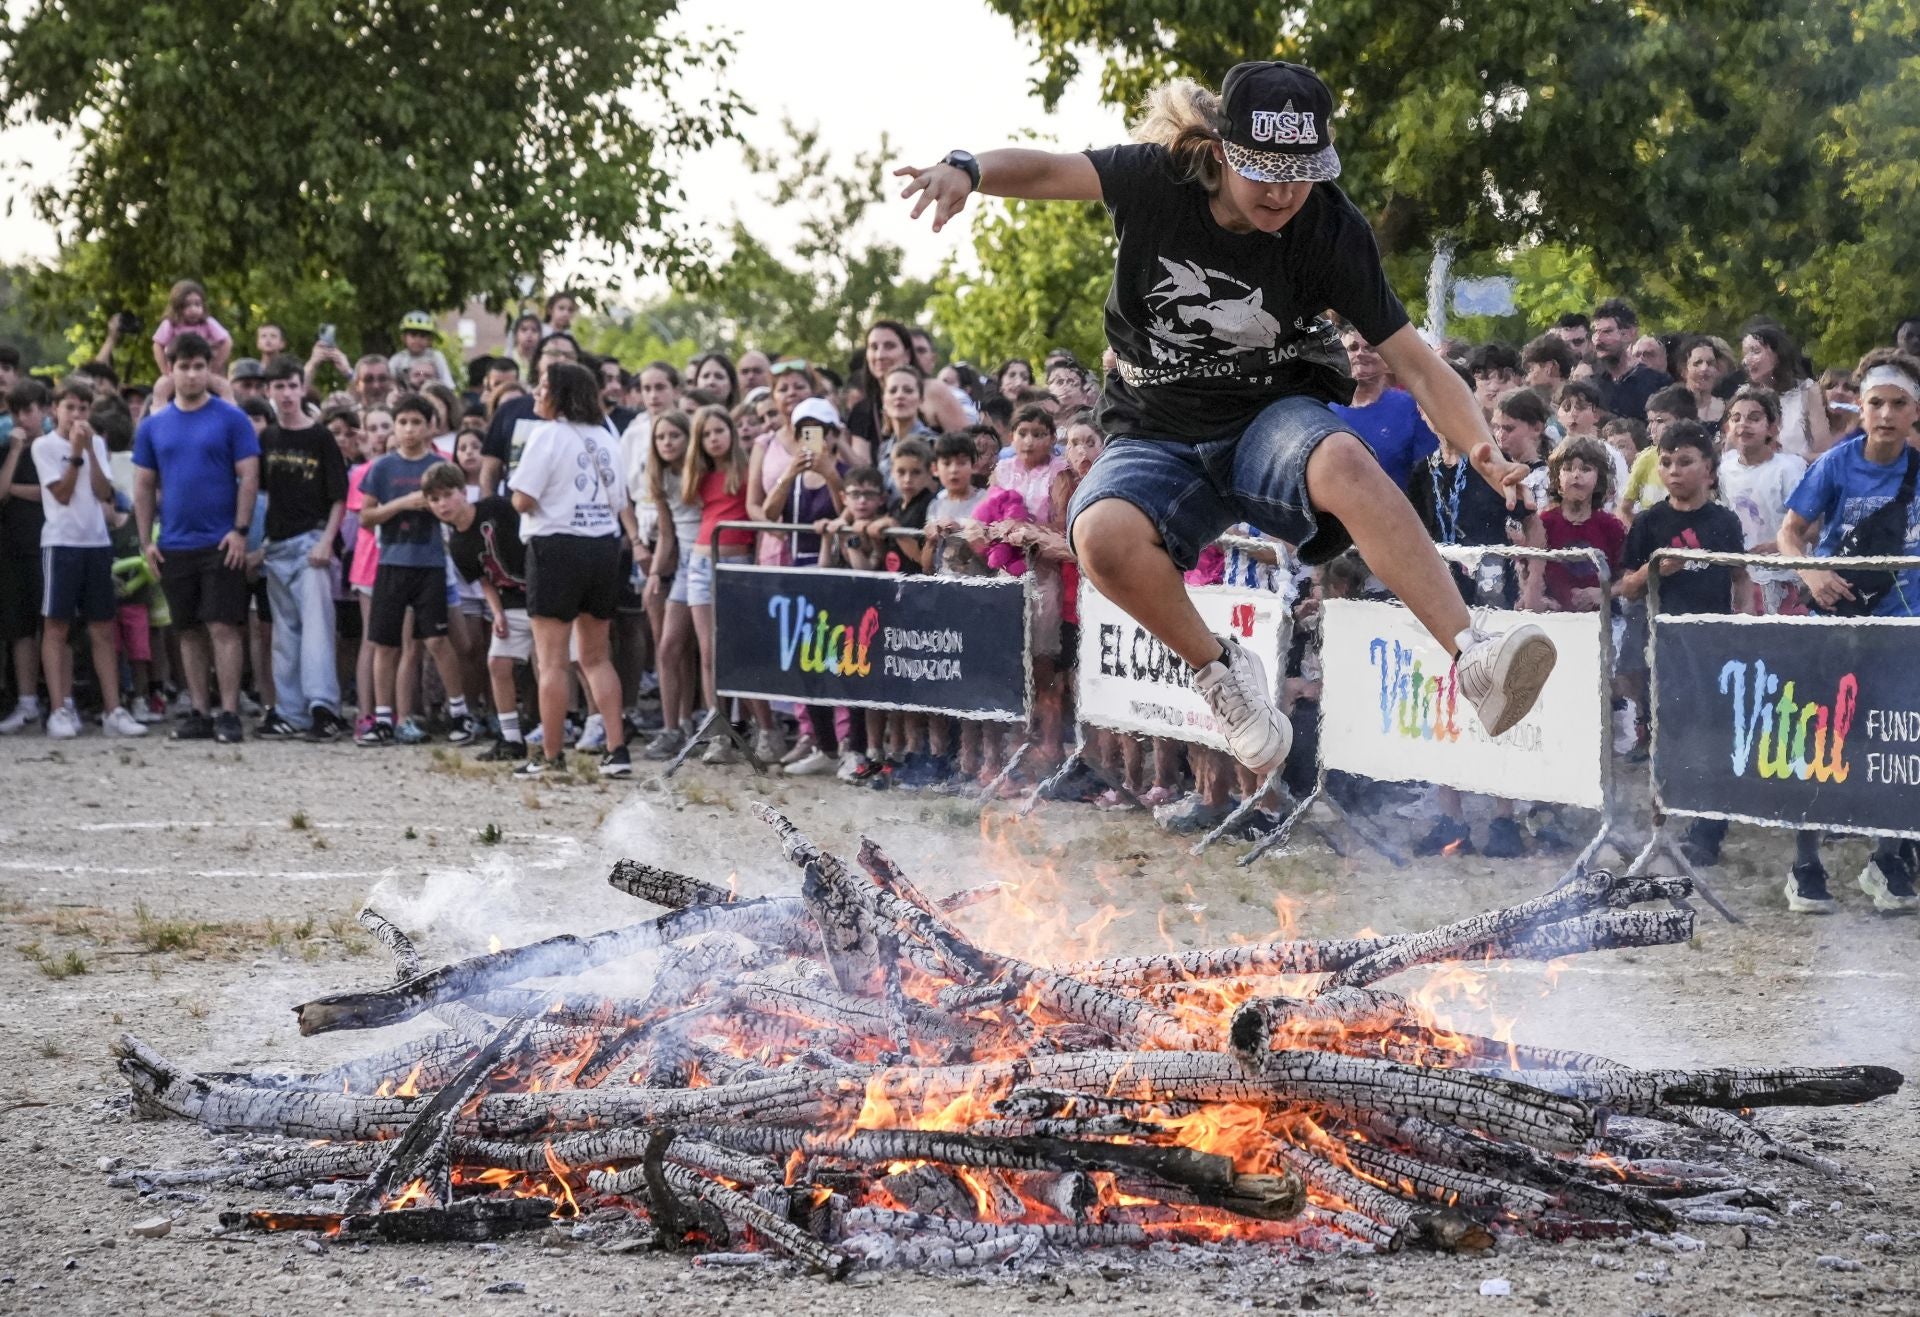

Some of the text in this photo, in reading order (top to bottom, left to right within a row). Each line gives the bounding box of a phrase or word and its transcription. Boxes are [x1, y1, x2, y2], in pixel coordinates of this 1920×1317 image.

[1251, 110, 1319, 145] USA
[767, 594, 880, 678] Vital
[1100, 623, 1128, 678] EL
[1369, 637, 1463, 743] Vital
[1718, 658, 1859, 784] Vital
